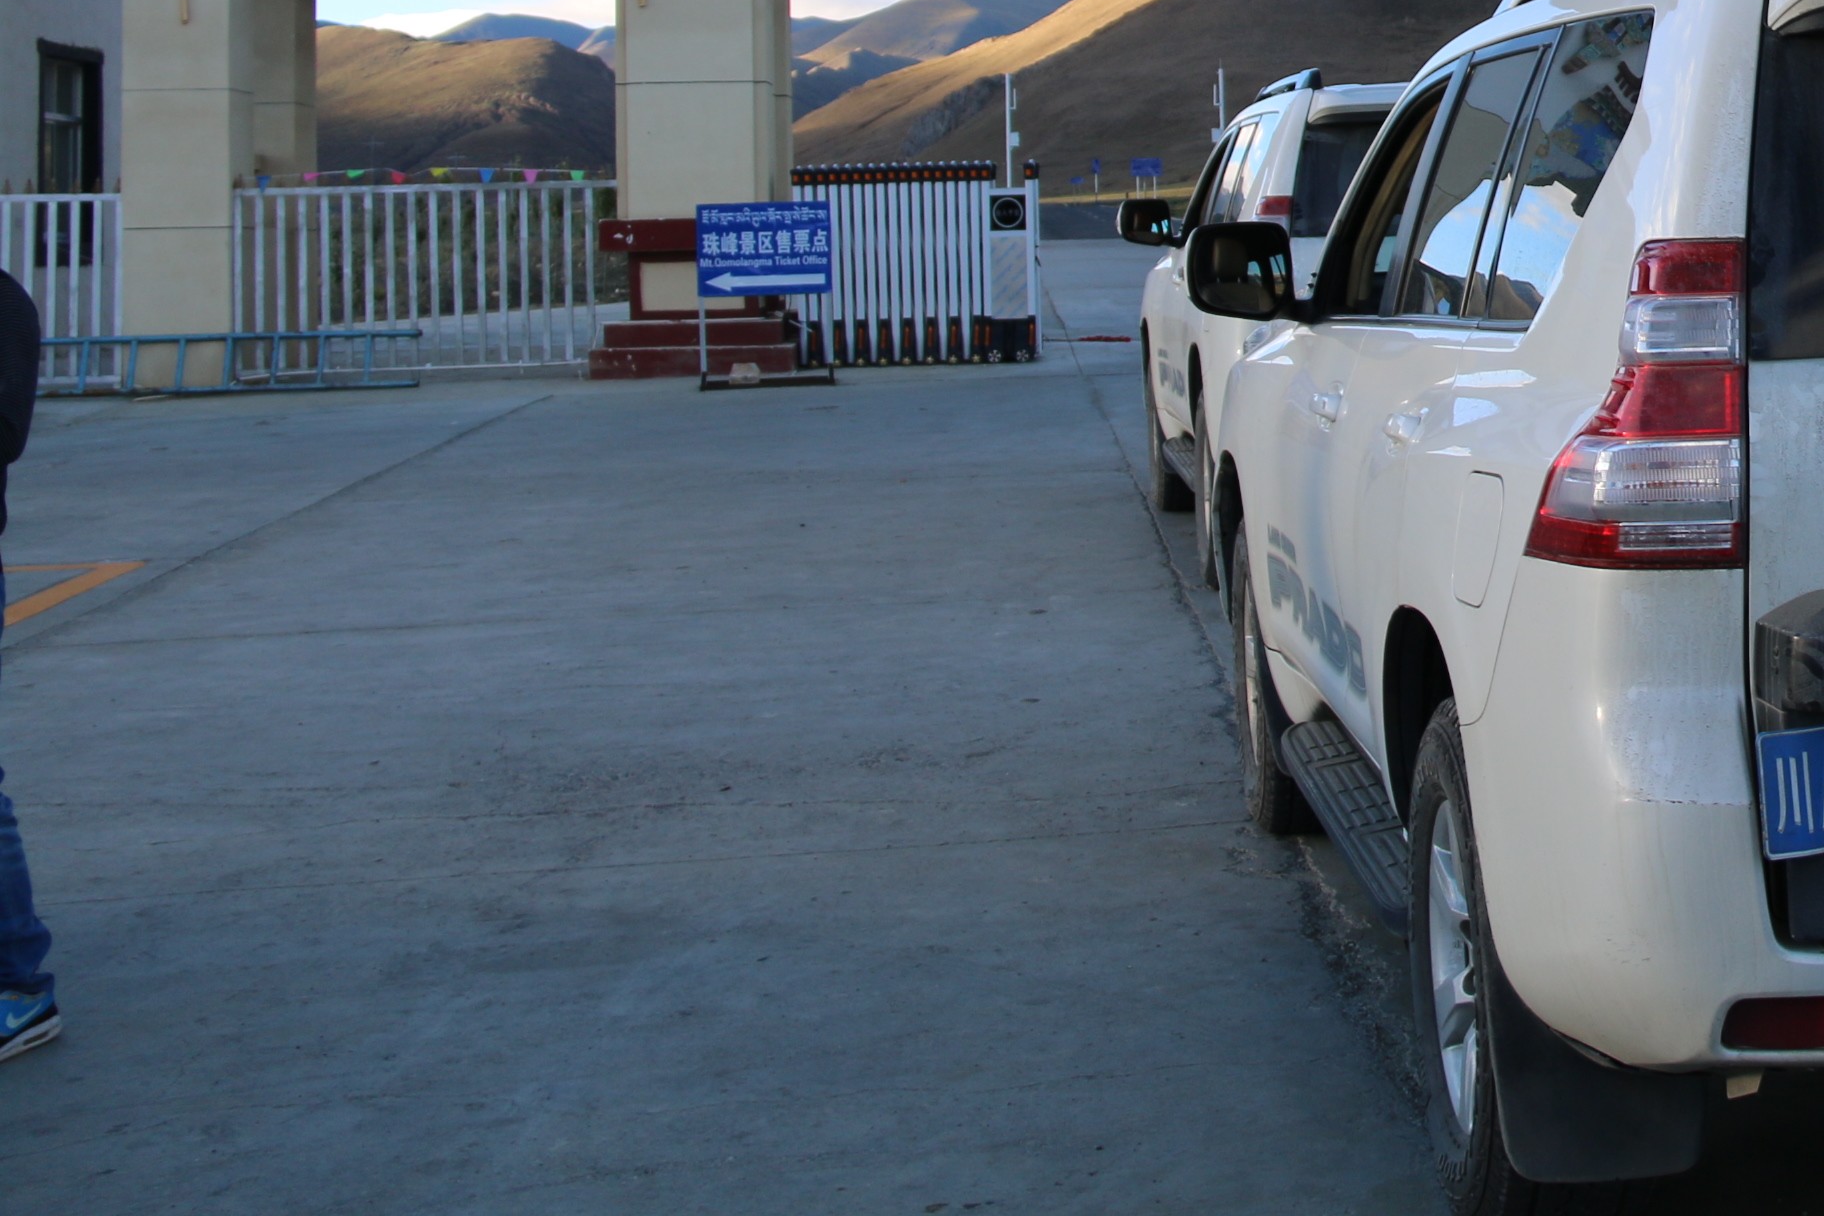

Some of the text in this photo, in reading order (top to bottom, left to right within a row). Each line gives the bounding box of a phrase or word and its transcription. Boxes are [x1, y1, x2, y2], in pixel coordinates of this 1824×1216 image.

[702, 229, 829, 256] 珠峰景区售票点
[774, 256, 801, 266] Ticket
[802, 255, 828, 265] Office
